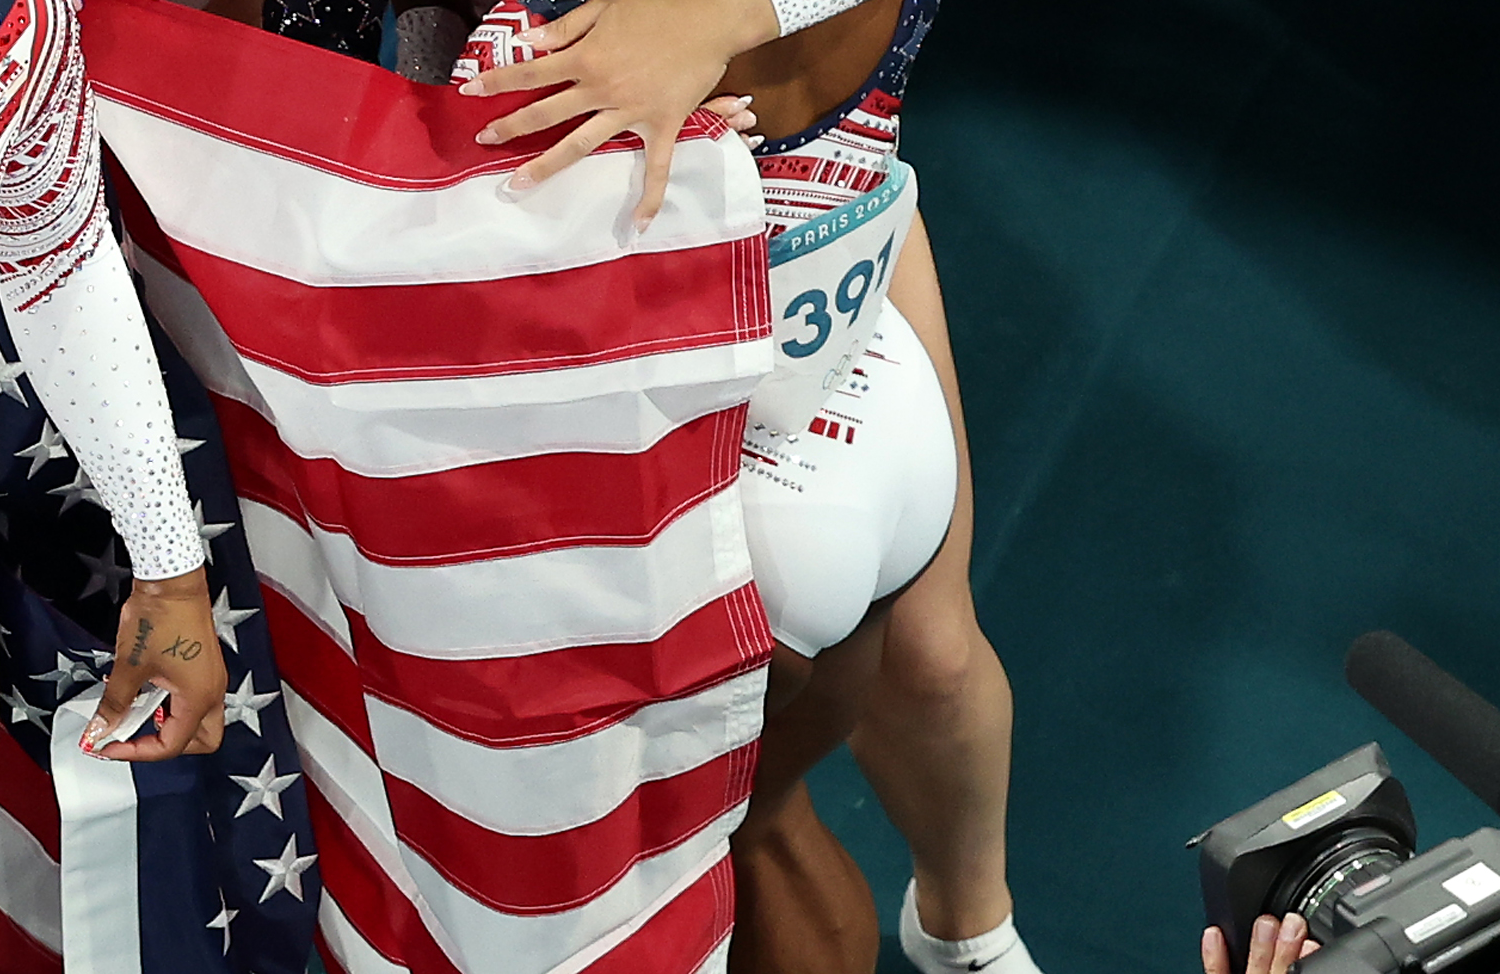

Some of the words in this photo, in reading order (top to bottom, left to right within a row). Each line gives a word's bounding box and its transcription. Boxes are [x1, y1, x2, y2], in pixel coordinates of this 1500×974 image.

[791, 213, 850, 251] PARIS
[781, 228, 896, 359] 391
[161, 635, 203, 662] XO
